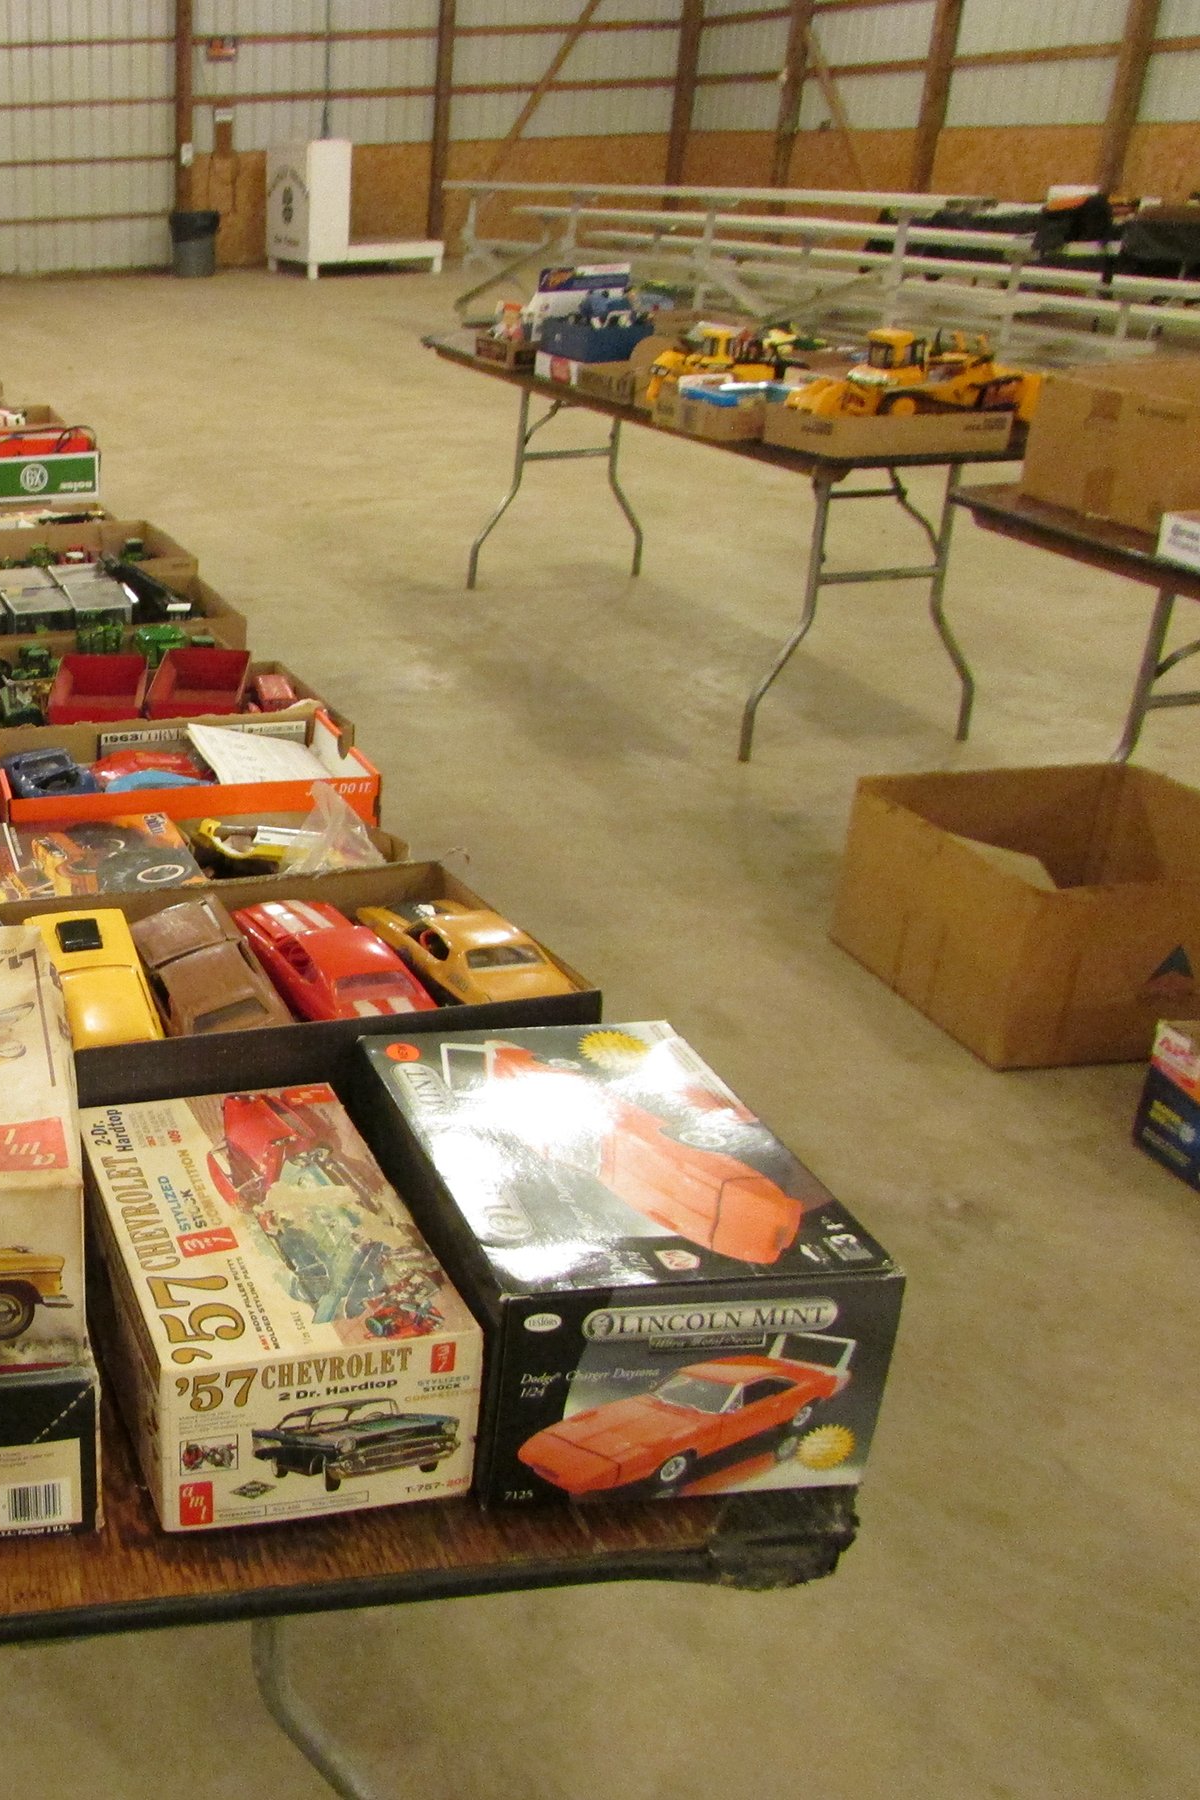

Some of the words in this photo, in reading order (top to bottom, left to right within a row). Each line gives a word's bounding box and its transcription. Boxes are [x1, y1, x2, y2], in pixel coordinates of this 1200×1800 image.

[103, 732, 139, 743] 1963
[338, 783, 357, 794] DO
[110, 1109, 133, 1152] Hardtop
[101, 1156, 180, 1271] CHEVROLET
[158, 1175, 191, 1232] STYLIZED
[227, 1258, 246, 1281] PUTTY
[237, 1257, 254, 1280] PARTS
[237, 1283, 256, 1309] FILLER
[249, 1282, 269, 1313] STYLING
[148, 1275, 246, 1364] '57
[249, 1311, 263, 1332] BODY
[263, 1316, 280, 1348] MOLDED
[618, 1310, 744, 1334] LINCOLN
[752, 1304, 829, 1328] MINT
[260, 1347, 413, 1390] CHEVROLET
[613, 1367, 660, 1382] Daytona
[175, 1368, 259, 1412] '57
[278, 1392, 292, 1402] 2
[296, 1388, 321, 1400] Dr.
[326, 1378, 399, 1397] Hardtop
[422, 1383, 462, 1393] STOCK
[519, 1386, 547, 1399] 1/24
[182, 1483, 209, 1522] amt
